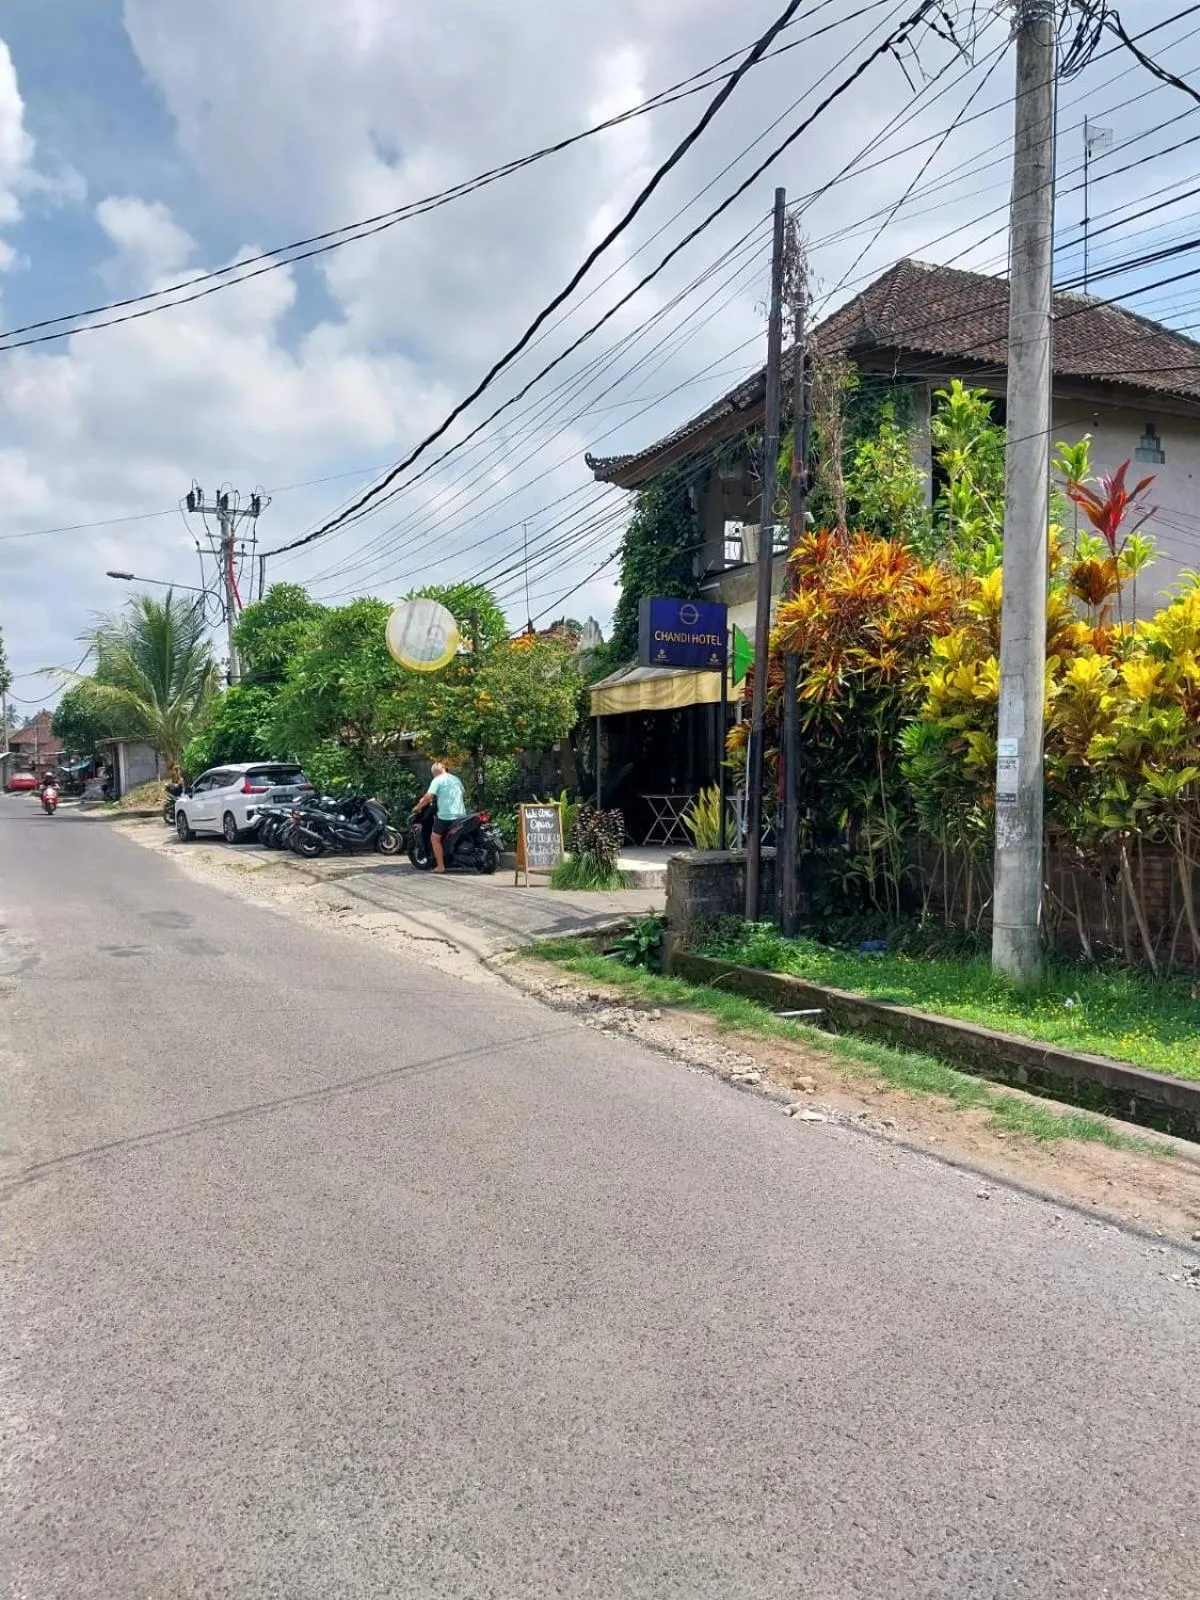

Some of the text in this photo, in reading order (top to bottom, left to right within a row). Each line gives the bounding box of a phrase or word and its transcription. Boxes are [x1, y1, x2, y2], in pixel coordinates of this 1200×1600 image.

[654, 630, 722, 646] CHANDI HOTEL
[530, 819, 554, 832] Open
